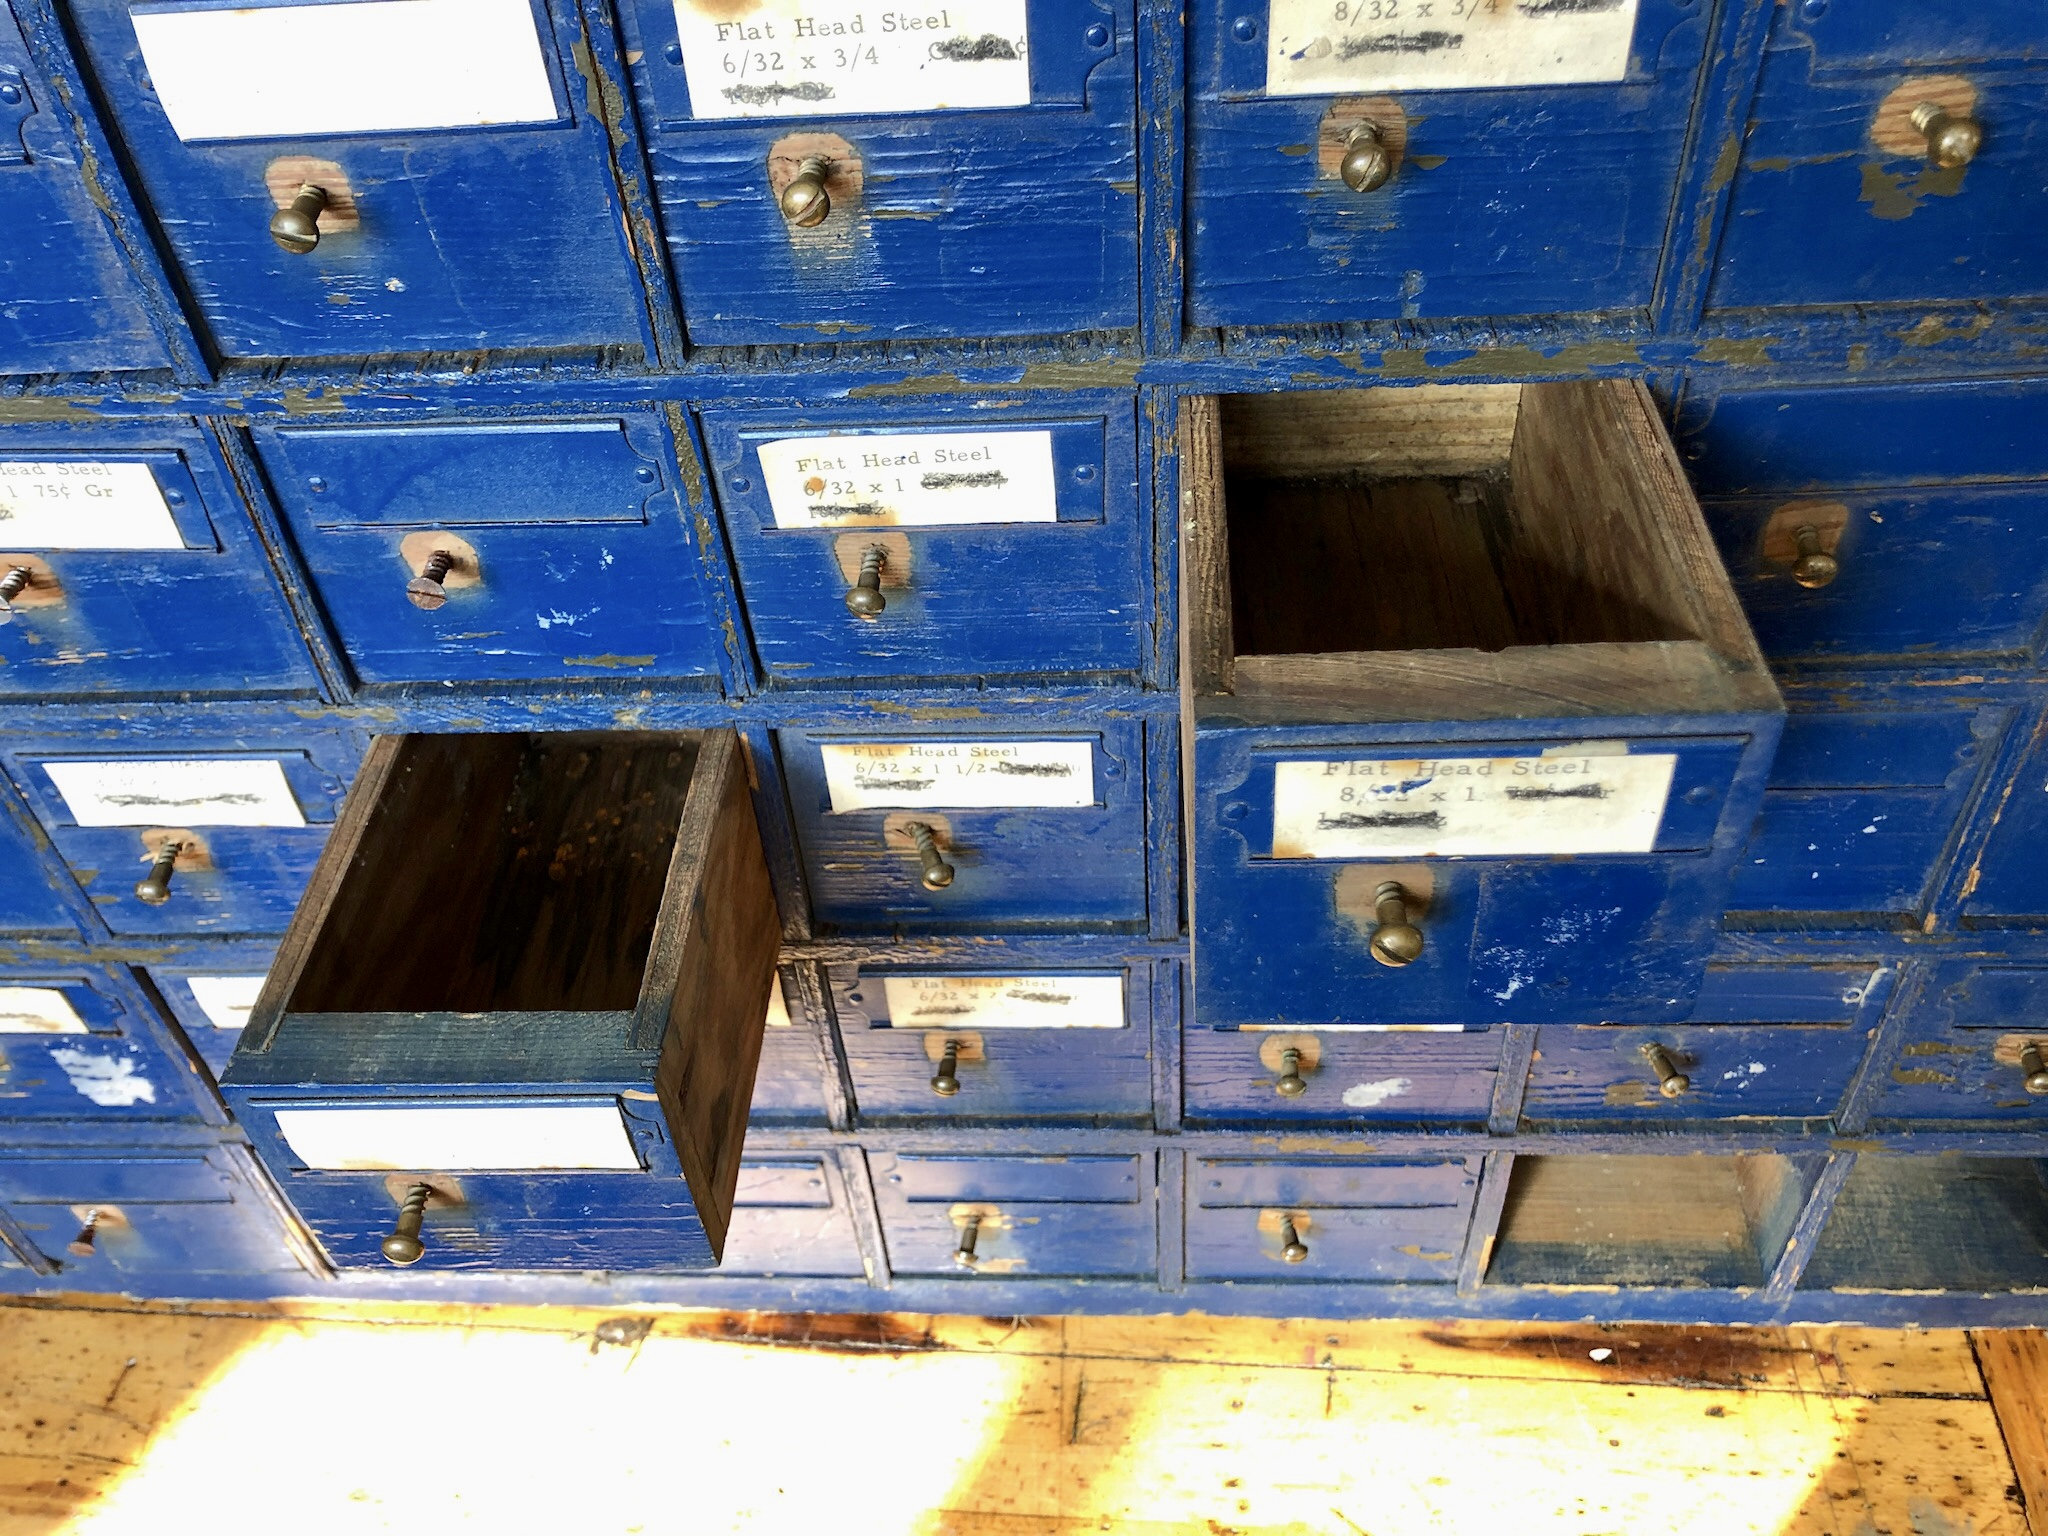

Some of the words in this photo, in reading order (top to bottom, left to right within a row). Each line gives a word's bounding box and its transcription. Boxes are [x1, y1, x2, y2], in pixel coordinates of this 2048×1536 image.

[1334, 0, 1398, 27] 8/32
[1416, 3, 1433, 18] x
[715, 22, 775, 42] Flat
[794, 14, 865, 38] Head
[882, 10, 952, 33] Steel
[722, 48, 785, 78] 6/32
[802, 55, 817, 70] x
[835, 43, 880, 72] 3/4
[796, 457, 847, 473] Flat
[862, 451, 921, 469] Head
[934, 446, 993, 464] Steel
[56, 462, 113, 476] Steel
[85, 484, 113, 498] Gr
[803, 479, 857, 500] 6/32
[870, 482, 884, 494] x
[853, 746, 895, 757] Flat
[908, 746, 959, 758] Head
[970, 746, 1019, 758] Steel
[855, 763, 900, 776] 6/32
[911, 764, 924, 775] x
[1322, 761, 1390, 777] Flat
[1414, 761, 1494, 778] Head
[1511, 759, 1593, 776] Steel
[1429, 790, 1448, 803] x
[911, 978, 948, 989] Flat
[960, 978, 1004, 989] Head
[1014, 978, 1057, 989] Steel
[919, 991, 959, 1002] 6/32
